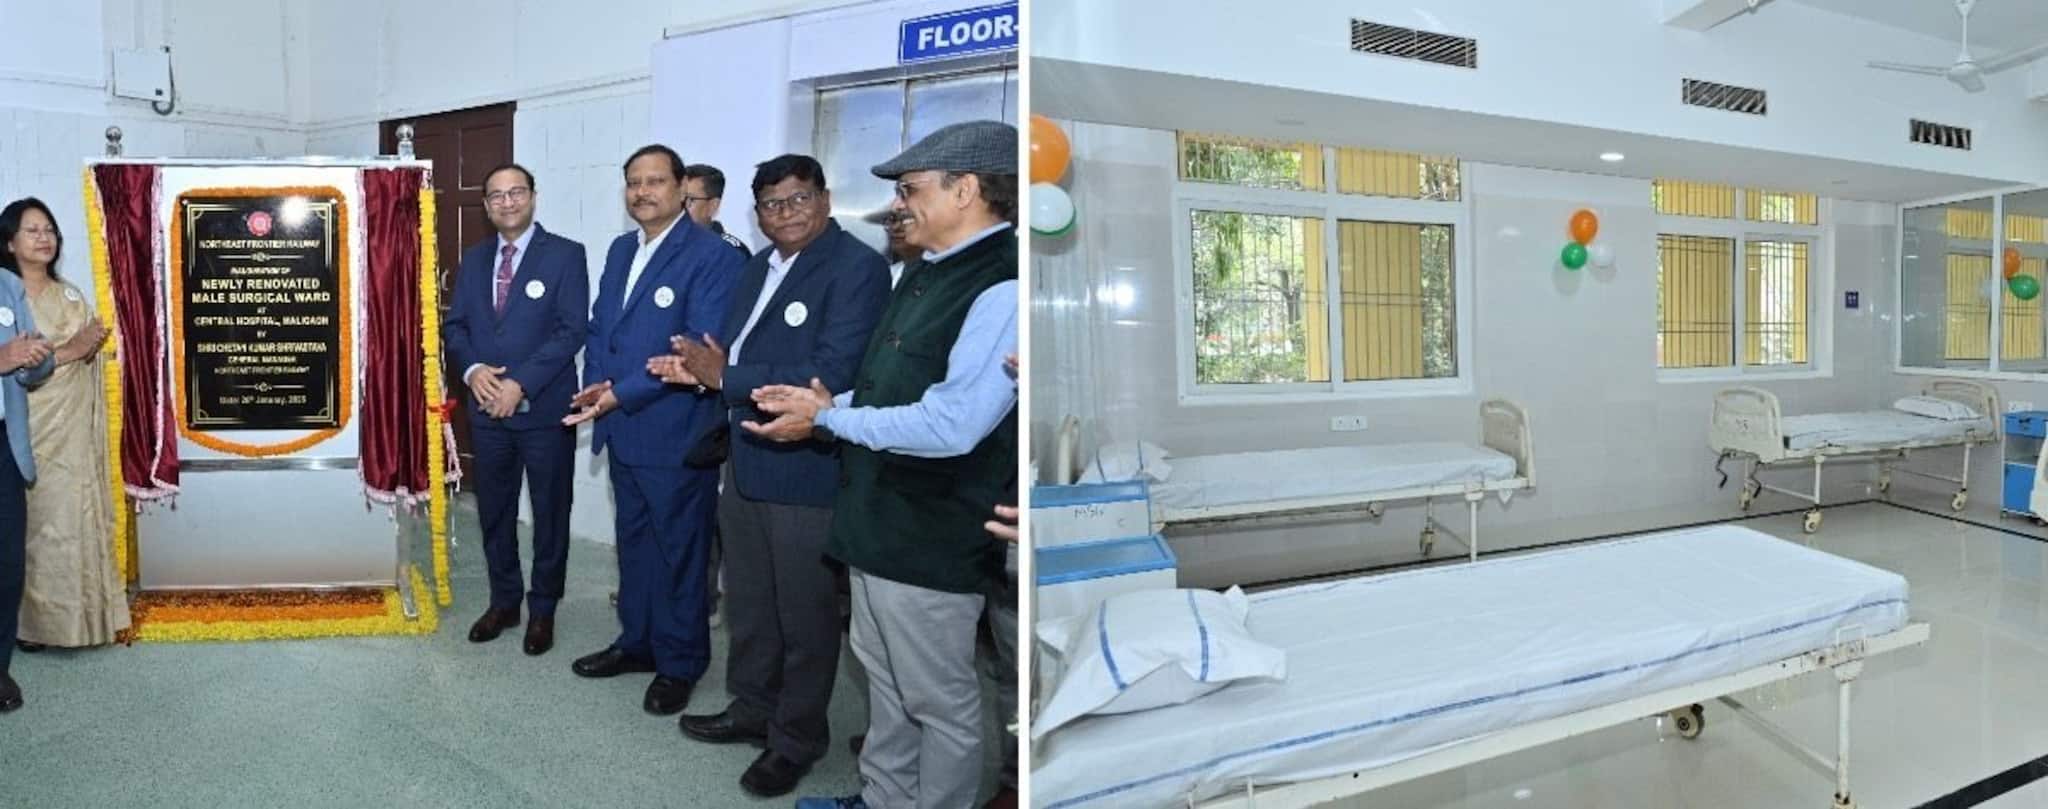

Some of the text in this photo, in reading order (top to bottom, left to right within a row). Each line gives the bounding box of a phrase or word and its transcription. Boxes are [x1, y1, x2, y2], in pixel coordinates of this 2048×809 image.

[199, 240, 320, 248] NORTHEAST FRONTIER RAILWAY
[202, 279, 320, 289] NEWLY RENOVATED
[192, 292, 330, 303] MALE SURGICAL WARD
[194, 316, 329, 326] CENTRAL HOSPITAL, MALIGAON
[248, 343, 275, 352] KUMAR
